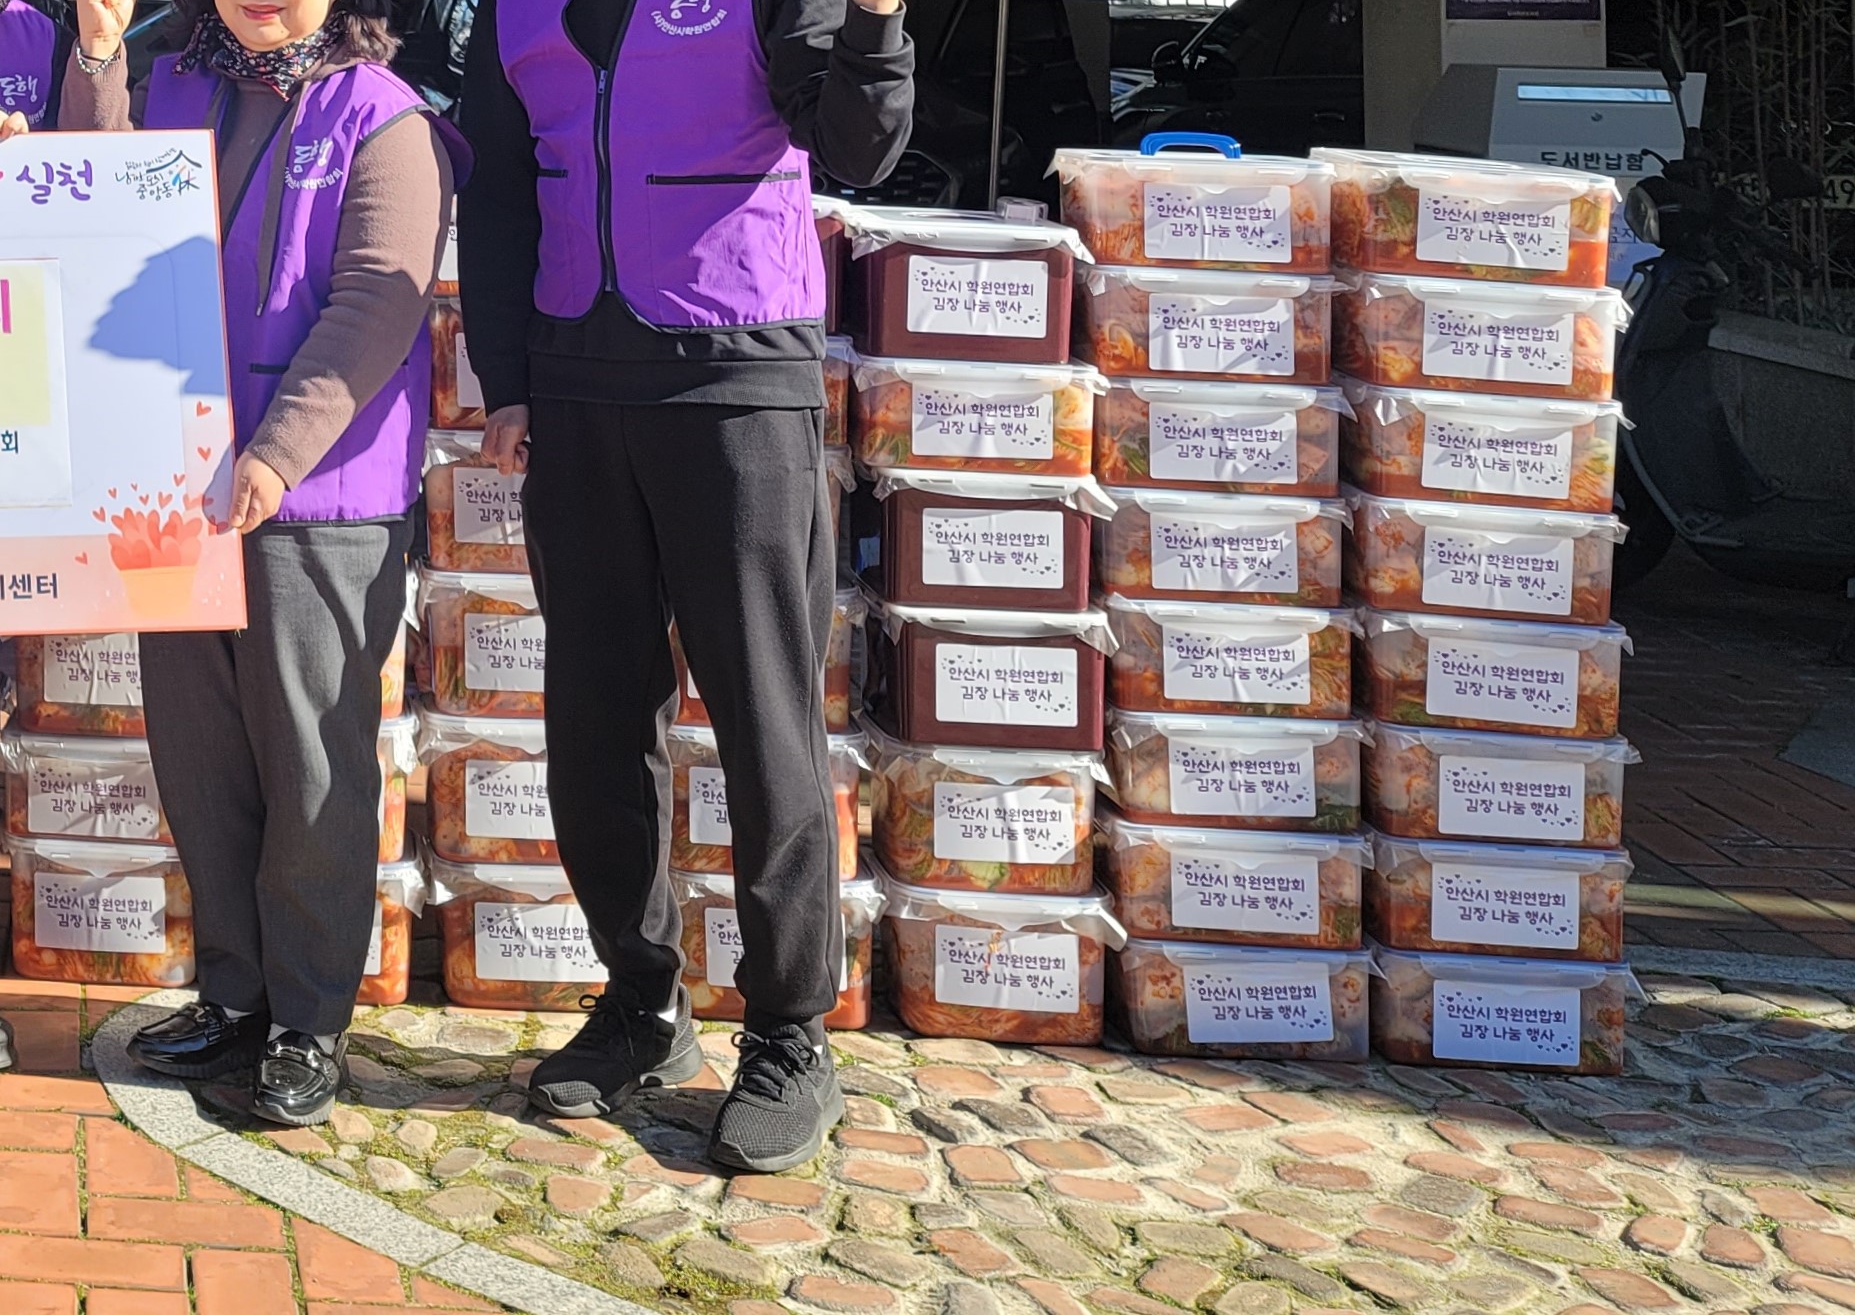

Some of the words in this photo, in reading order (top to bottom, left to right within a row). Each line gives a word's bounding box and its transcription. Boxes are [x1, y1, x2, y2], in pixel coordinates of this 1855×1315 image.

[1540, 151, 1645, 171] 도서반납함
[15, 160, 94, 205] 실천
[136, 182, 173, 201] 중앙동
[920, 278, 961, 293] 안산시
[966, 280, 1034, 297] 학원연합회
[932, 296, 960, 312] 김장
[963, 299, 991, 313] 나눔
[995, 300, 1023, 314] 행사
[948, 667, 990, 682] 안산시
[994, 668, 1064, 685] 학원연합회
[1441, 660, 1486, 678] 안산시
[1490, 665, 1565, 686] 학원연합회
[960, 685, 989, 700] 김장
[992, 687, 1021, 702] 나눔
[1024, 688, 1053, 702] 행사
[1453, 680, 1484, 697] 김장
[1487, 684, 1518, 700] 나눔
[1521, 686, 1552, 703] 행사
[1452, 779, 1495, 795] 안산시
[1500, 781, 1572, 798] 학원연합회
[1464, 798, 1494, 813] 김장
[1497, 800, 1526, 815] 나눔
[1530, 801, 1560, 816] 행사
[1184, 872, 1228, 888] 안산시
[1232, 874, 1306, 892] 학원연합회
[1197, 891, 1228, 907] 김장
[1231, 894, 1261, 909] 나눔
[1264, 895, 1294, 911] 행사
[1197, 987, 1241, 1001] 안산시
[1244, 985, 1318, 1000] 학원연합회
[1211, 1005, 1242, 1020] 김장
[1244, 1006, 1275, 1020] 나눔
[1277, 1004, 1308, 1019] 행사
[1447, 1004, 1490, 1020] 안산시
[1494, 1007, 1567, 1024] 학원연합회
[1459, 1023, 1489, 1039] 김장
[1492, 1026, 1522, 1041] 나눔
[1526, 1027, 1556, 1042] 행사
